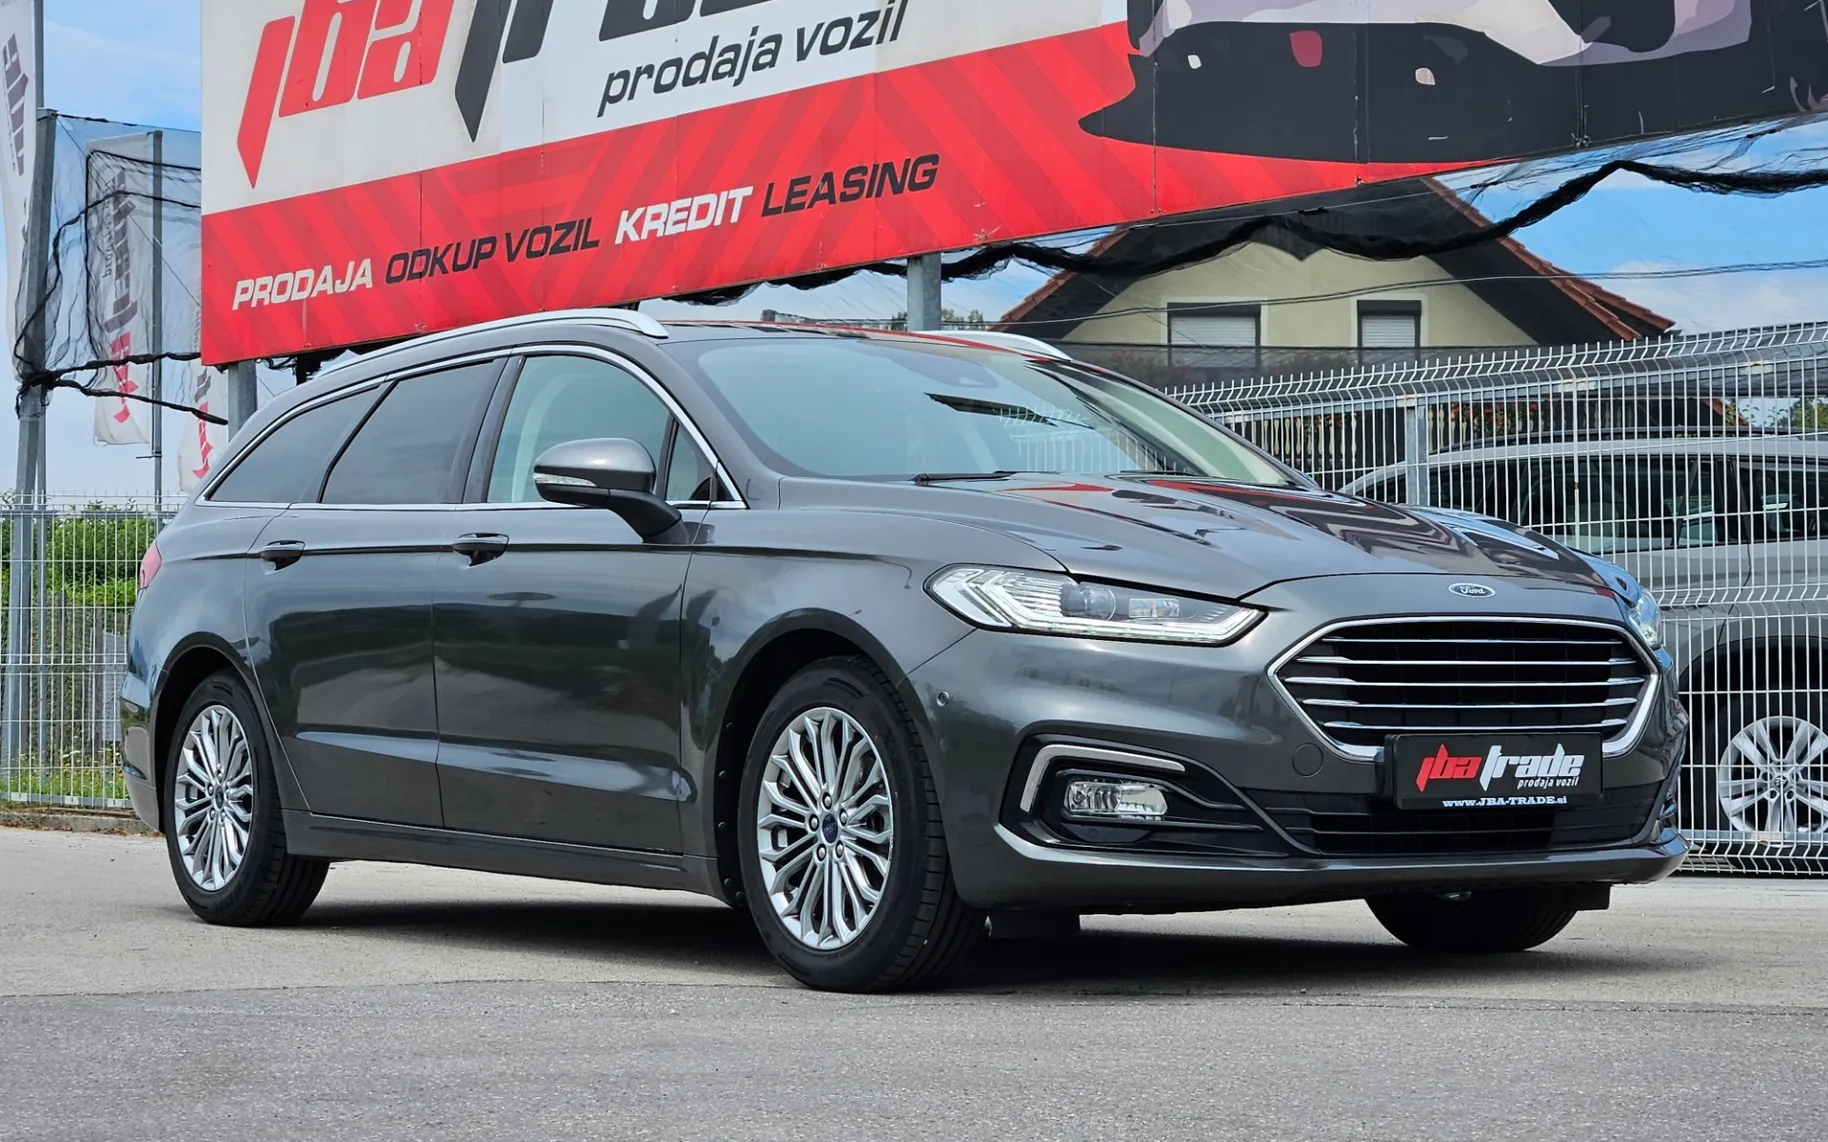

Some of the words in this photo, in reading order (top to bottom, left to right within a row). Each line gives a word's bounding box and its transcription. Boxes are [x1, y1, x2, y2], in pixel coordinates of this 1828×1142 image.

[597, 26, 783, 117] prodaja
[795, 0, 908, 62] vozil
[232, 257, 373, 311] PRODAJA
[385, 235, 497, 285] ODKUP
[505, 216, 600, 260] VOZIL
[614, 186, 754, 245] KREDIT
[760, 153, 940, 217] LEASING
[1442, 796, 1567, 808] www.JBA-TRADE.si
[1516, 776, 1553, 790] prodaja
[1555, 776, 1580, 788] vozil
